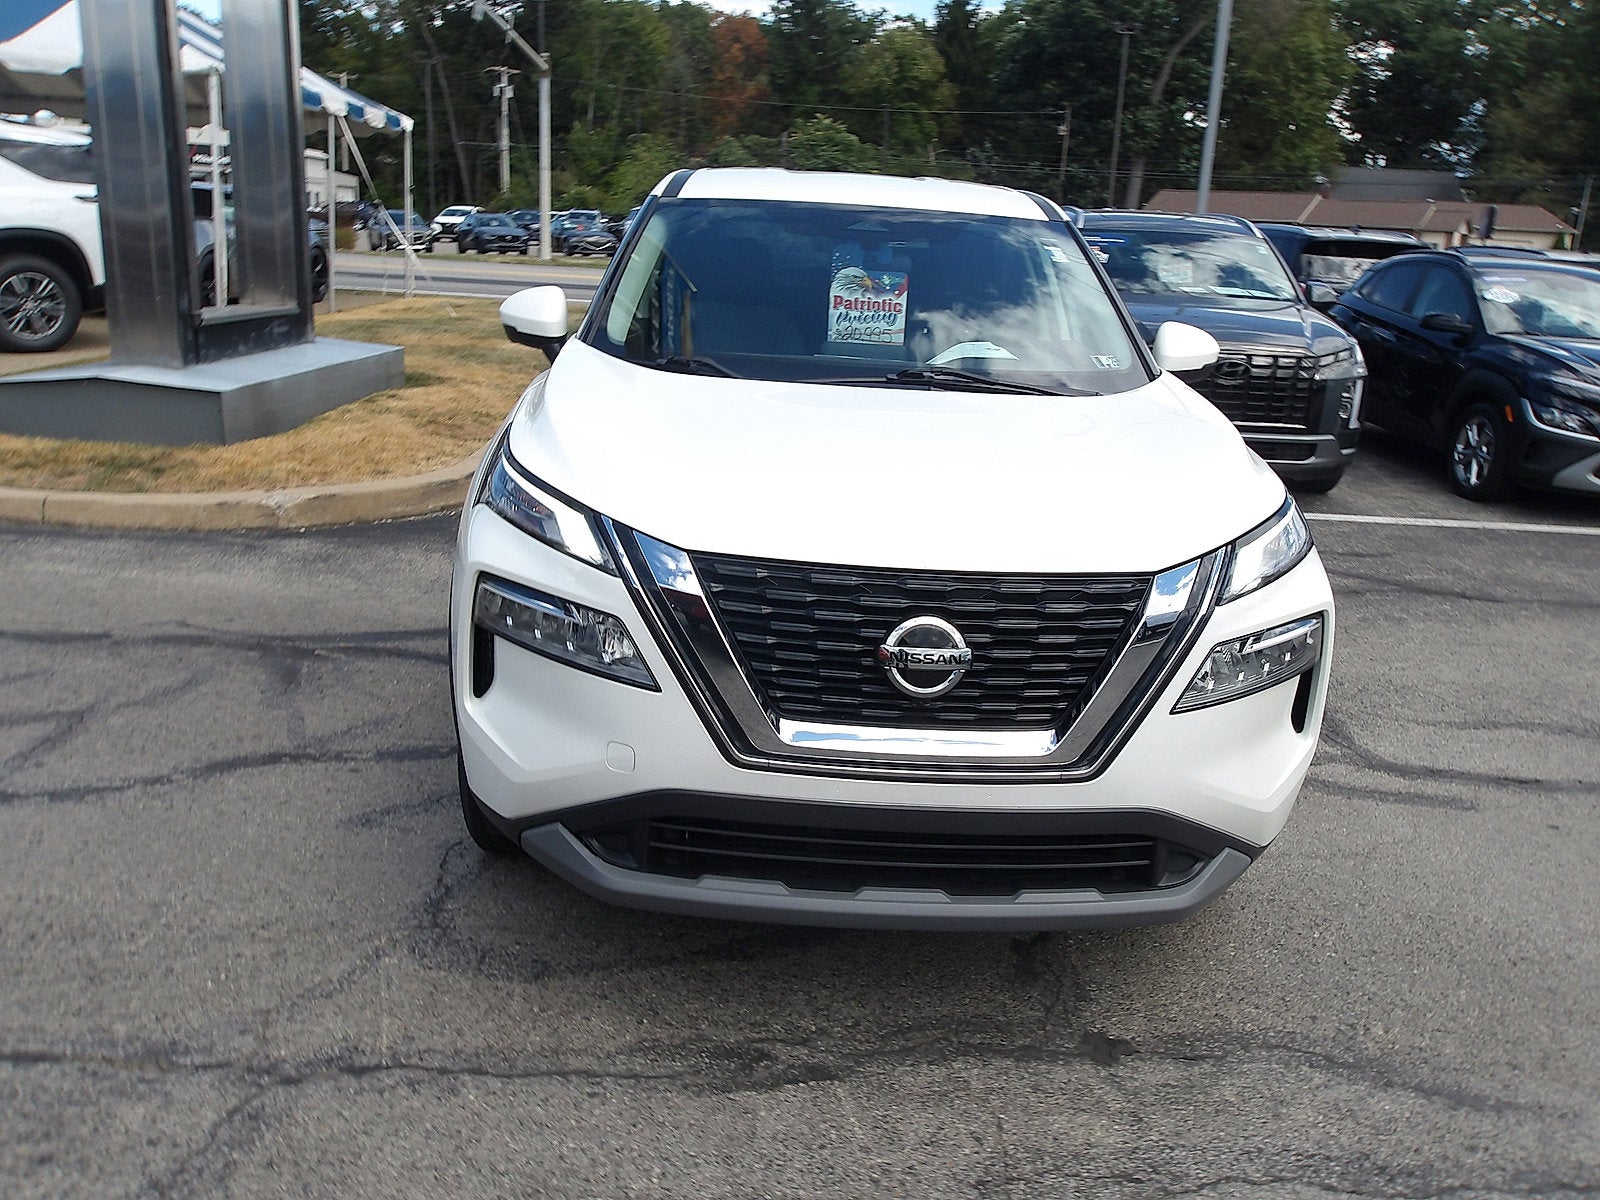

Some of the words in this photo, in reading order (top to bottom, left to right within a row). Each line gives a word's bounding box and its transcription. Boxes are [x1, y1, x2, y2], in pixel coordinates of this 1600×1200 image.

[833, 295, 903, 313] Patriotic
[836, 311, 898, 327] Pricing
[889, 652, 961, 666] NISSAN
